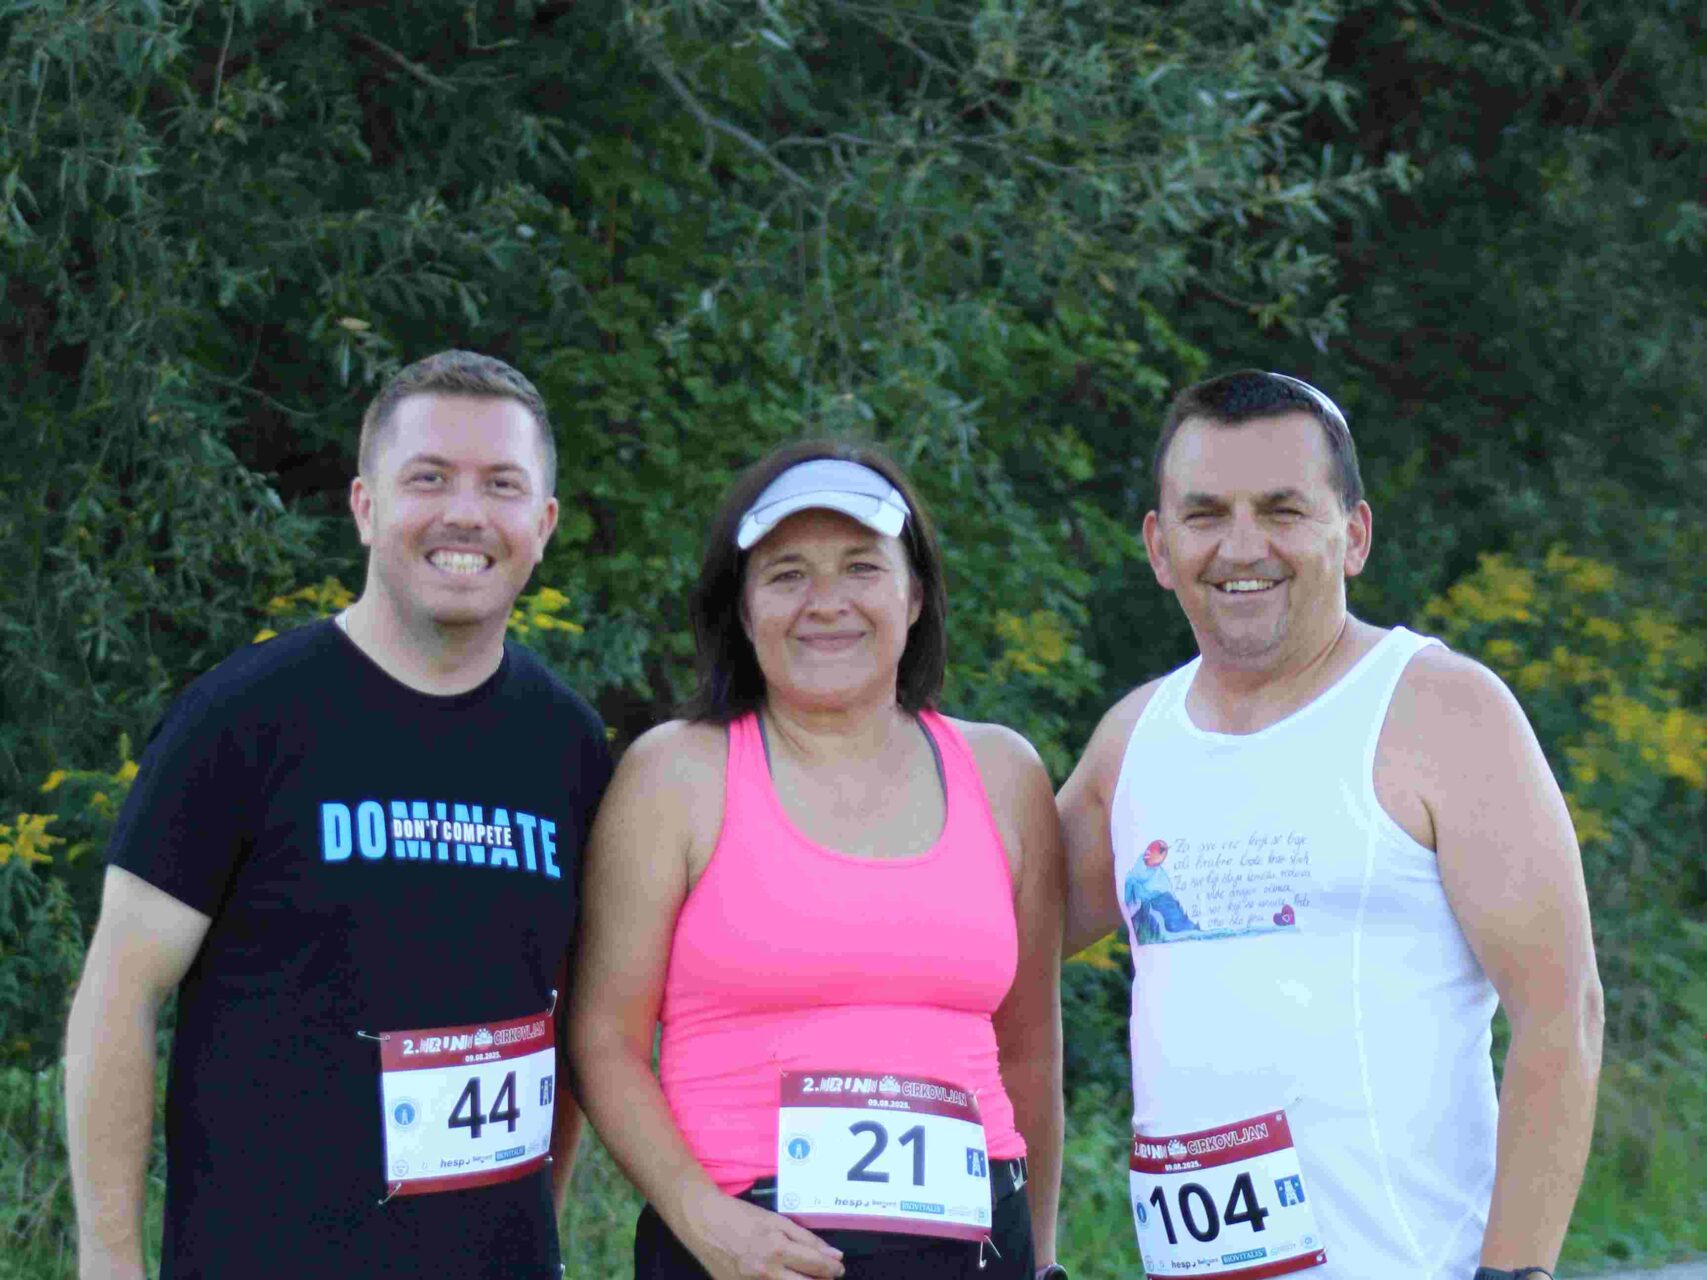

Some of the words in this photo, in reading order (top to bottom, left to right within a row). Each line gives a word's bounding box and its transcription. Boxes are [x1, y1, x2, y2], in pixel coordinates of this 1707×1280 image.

[322, 801, 561, 878] DOMINATE
[393, 818, 438, 840] DON'T
[443, 821, 513, 847] COMPETE
[448, 1070, 521, 1139] 44
[847, 1120, 926, 1187] 21
[1187, 1122, 1269, 1156] CIRKOVLJAN
[1150, 1172, 1270, 1245] 104
